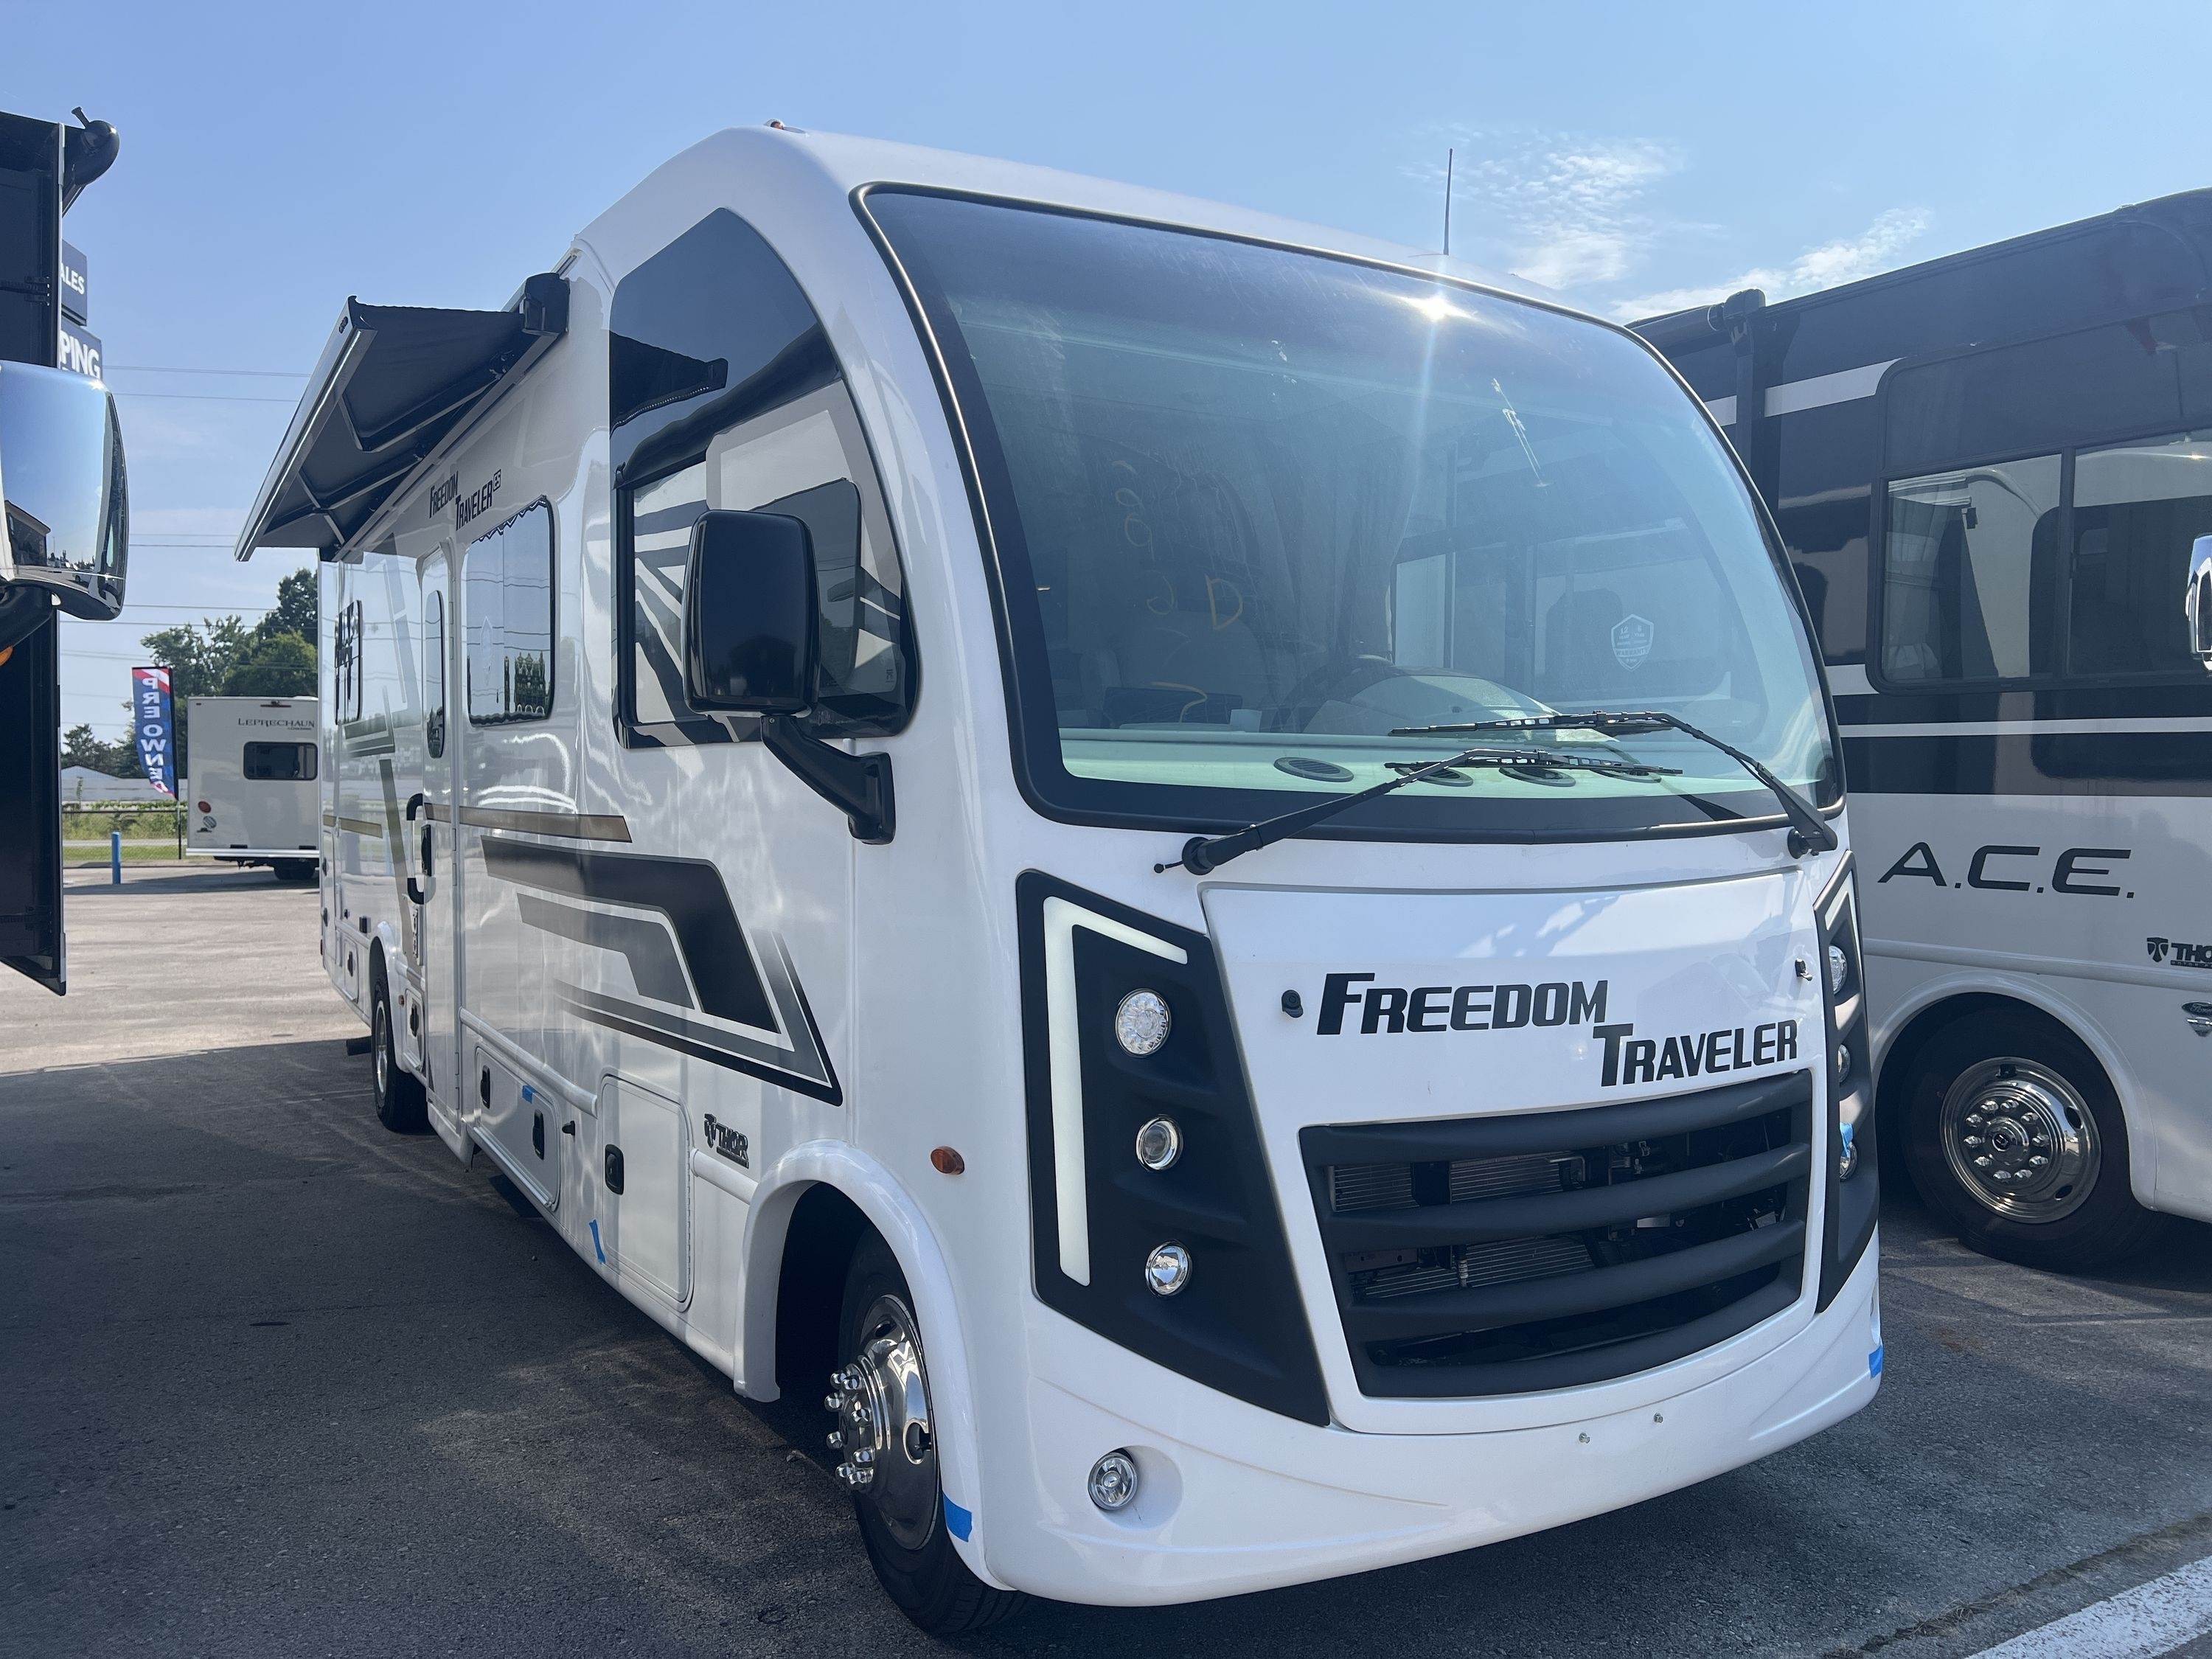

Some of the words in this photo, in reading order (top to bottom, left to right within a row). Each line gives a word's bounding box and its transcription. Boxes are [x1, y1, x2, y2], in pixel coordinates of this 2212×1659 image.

[59, 330, 100, 379] PING
[429, 470, 459, 518] FREEDOM
[456, 479, 493, 531] TRAVELER
[1205, 574, 1243, 630] D
[238, 717, 315, 728] LEPRECHAUN
[1877, 841, 2135, 898] A.C.E.
[1317, 972, 1608, 1035] FREEDOM
[1593, 1018, 1798, 1087] TRAVELER
